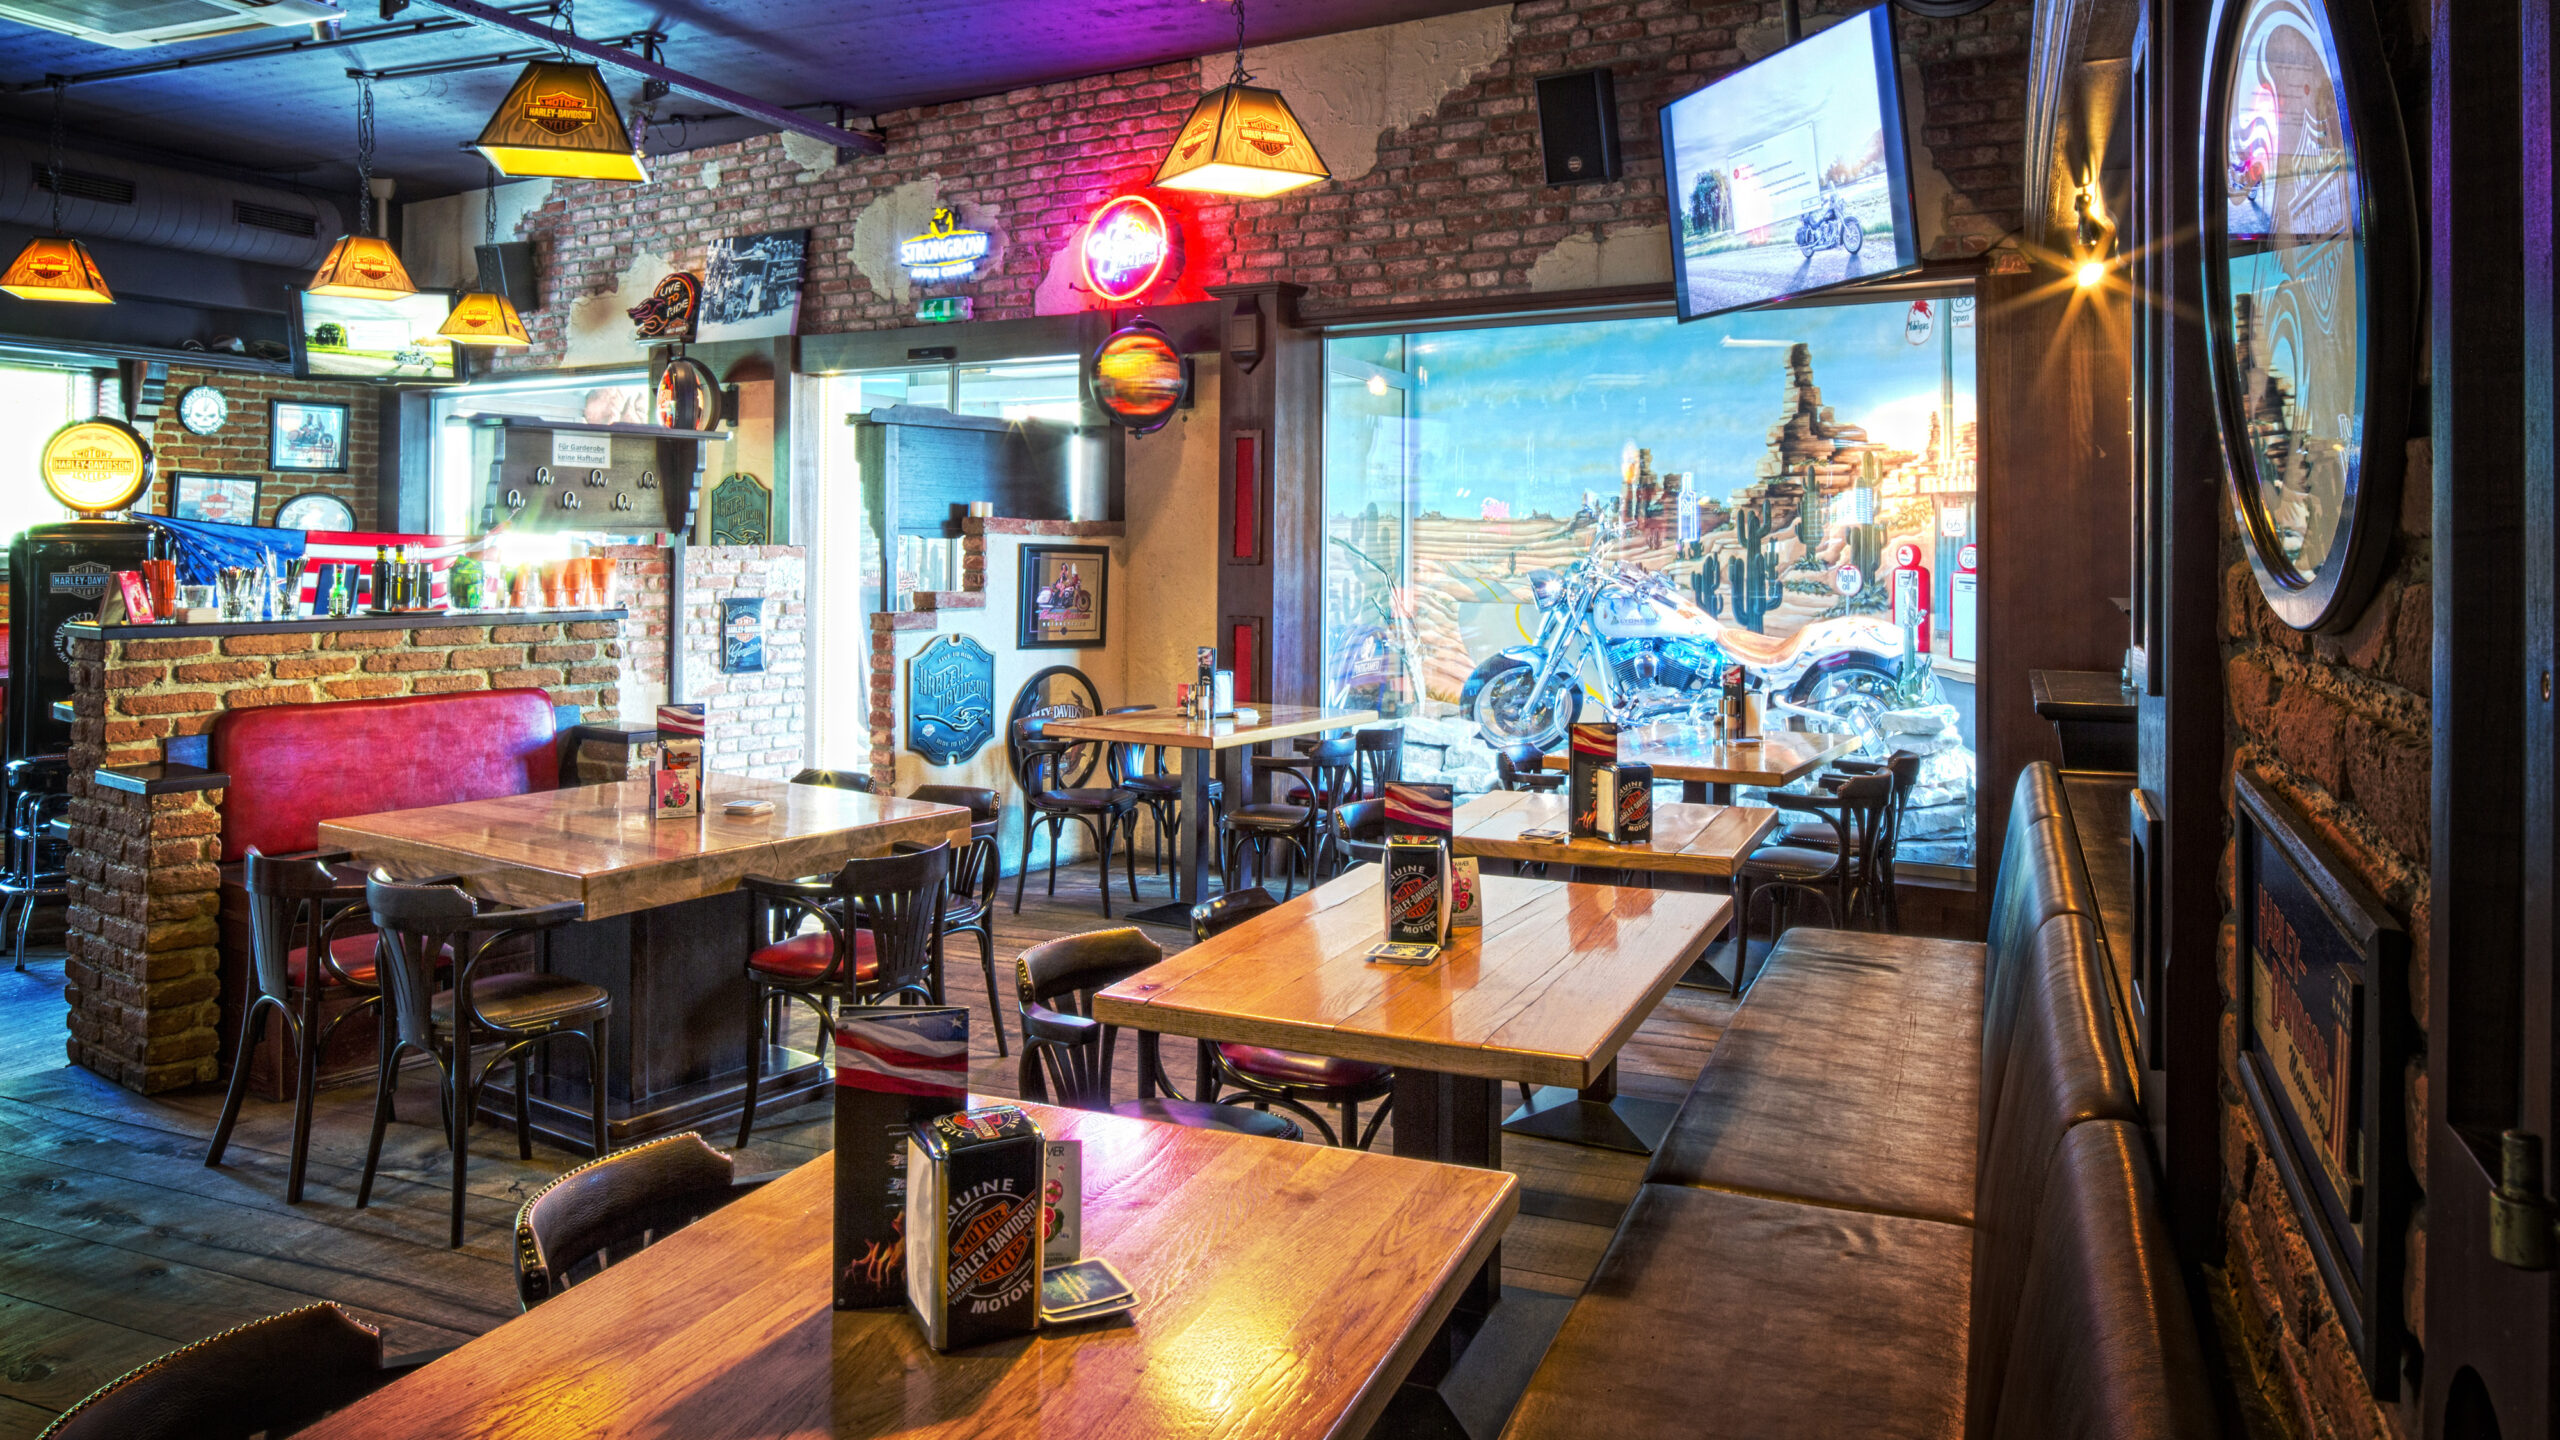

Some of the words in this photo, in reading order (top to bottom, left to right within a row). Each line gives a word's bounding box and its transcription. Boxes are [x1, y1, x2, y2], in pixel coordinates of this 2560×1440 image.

[544, 97, 580, 108] MOTOR
[528, 107, 592, 120] HARLEY-DAVIDSON
[900, 235, 987, 263] STRONGBOW
[660, 281, 681, 297] LIVE
[667, 292, 680, 306] TO
[667, 299, 689, 317] RIDE
[1952, 315, 1970, 326] open
[77, 449, 108, 458] MOTOR
[558, 442, 569, 450] Für
[570, 443, 606, 453] Garderobe
[55, 460, 132, 471] HARLEY-DAVIDSON
[557, 454, 577, 462] keine
[577, 455, 606, 464] Haftung!
[1837, 570, 1857, 582] Mobil
[1842, 581, 1851, 591] oil
[938, 653, 951, 664] LIVE
[960, 652, 974, 661] RIDE
[937, 679, 991, 716] DAVIDSON
[1627, 819, 1650, 832] MOTOR
[1402, 920, 1437, 935] MOTOR
[2271, 957, 2330, 1103] DAVIDSON
[958, 1208, 1006, 1255] MOTOR
[981, 1237, 1027, 1282] CYCLES
[970, 1278, 1034, 1315] MOTOR
